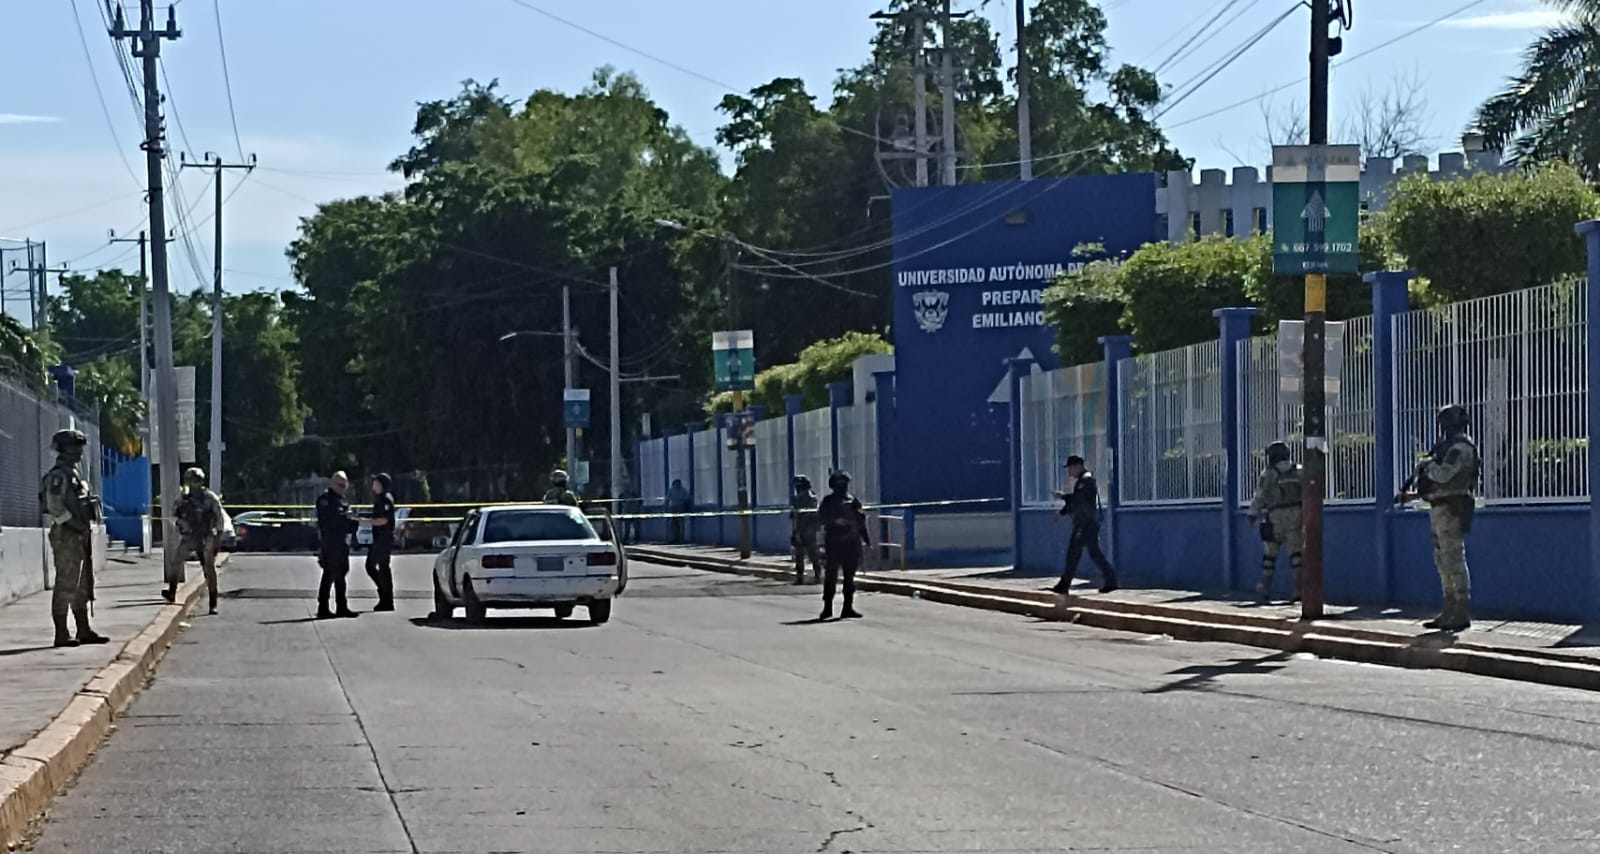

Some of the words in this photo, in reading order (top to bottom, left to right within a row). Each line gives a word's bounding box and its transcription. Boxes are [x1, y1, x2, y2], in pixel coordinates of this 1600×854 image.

[1332, 242, 1352, 253] 1702
[898, 268, 985, 287] UNIVERSIDAD
[989, 261, 1063, 283] AUTÓNOMA
[982, 289, 1043, 306] PREPAR
[972, 311, 1045, 328] EMILIANO
